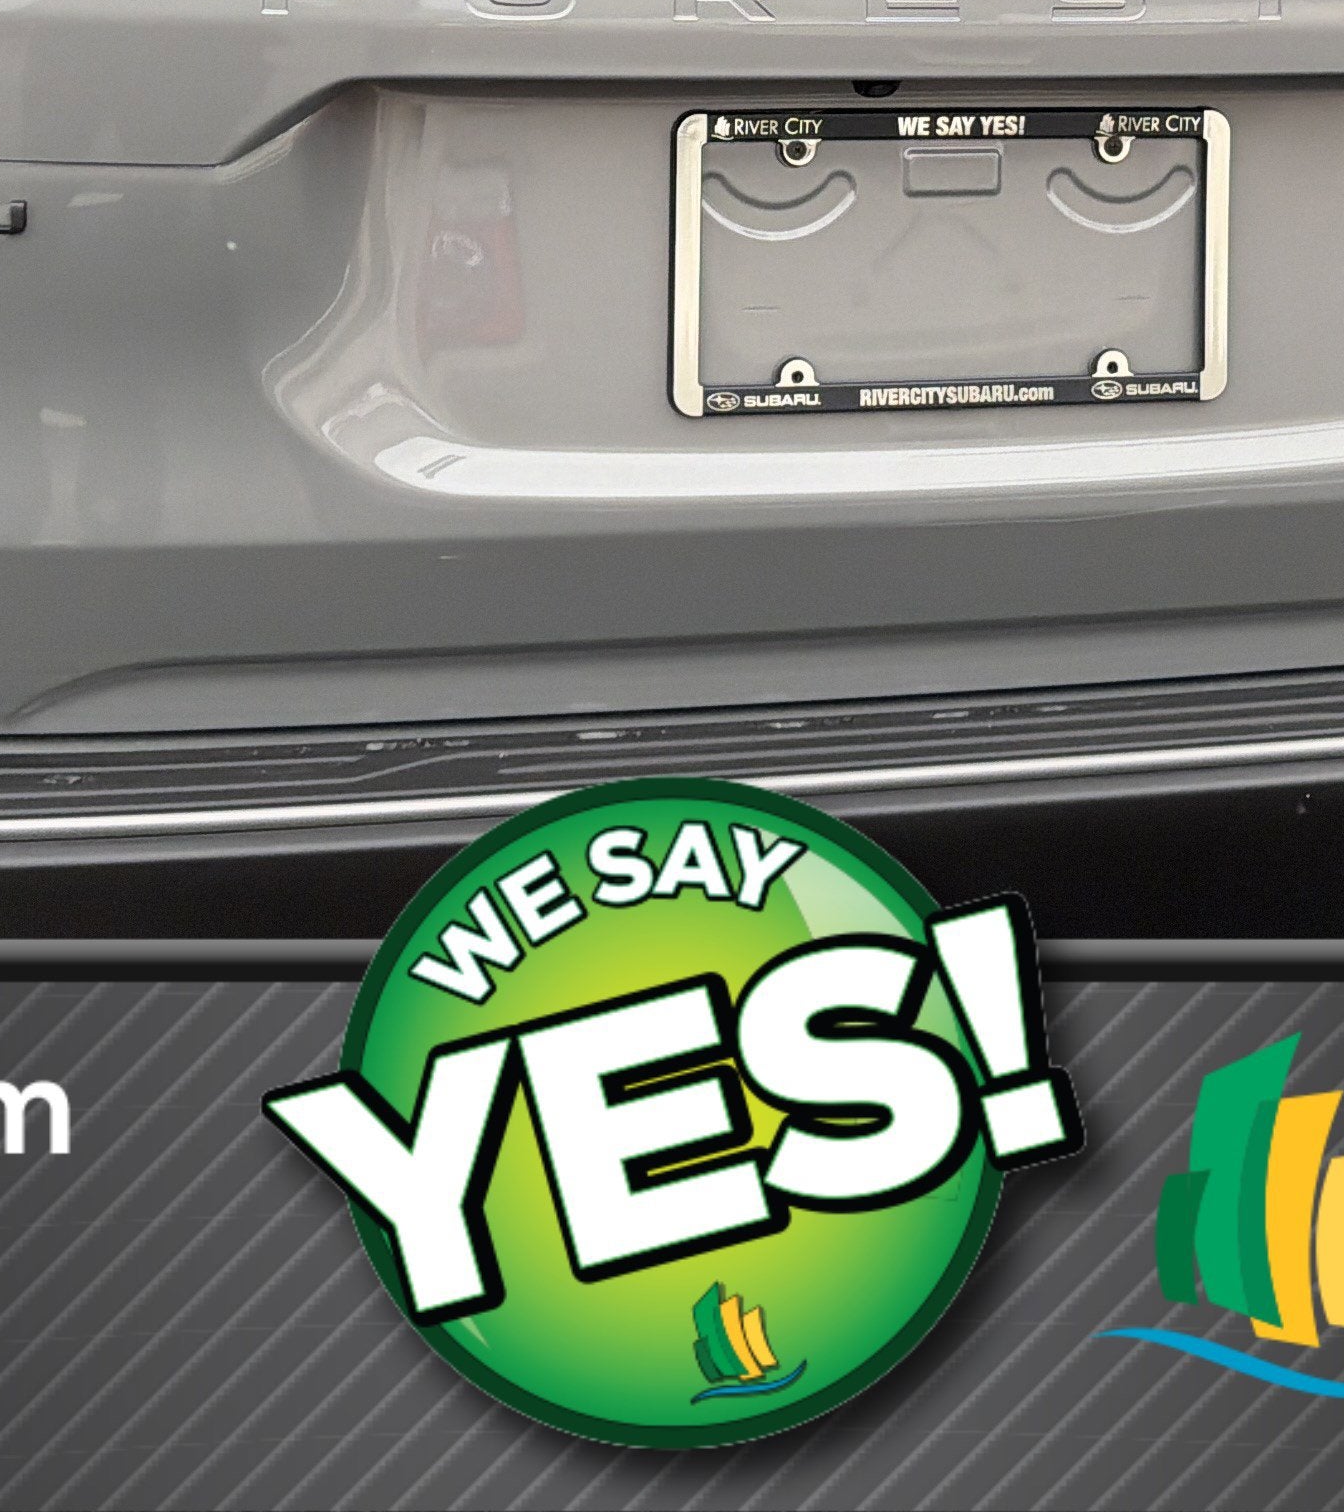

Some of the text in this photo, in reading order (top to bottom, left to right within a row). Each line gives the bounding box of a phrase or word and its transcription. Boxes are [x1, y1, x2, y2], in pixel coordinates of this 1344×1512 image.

[734, 117, 824, 136] RIVER CITY
[897, 115, 1027, 137] WE SAY YES!
[1118, 114, 1202, 133] RIVER CITY
[859, 384, 1054, 407] RIVERCITYSUBARU.com
